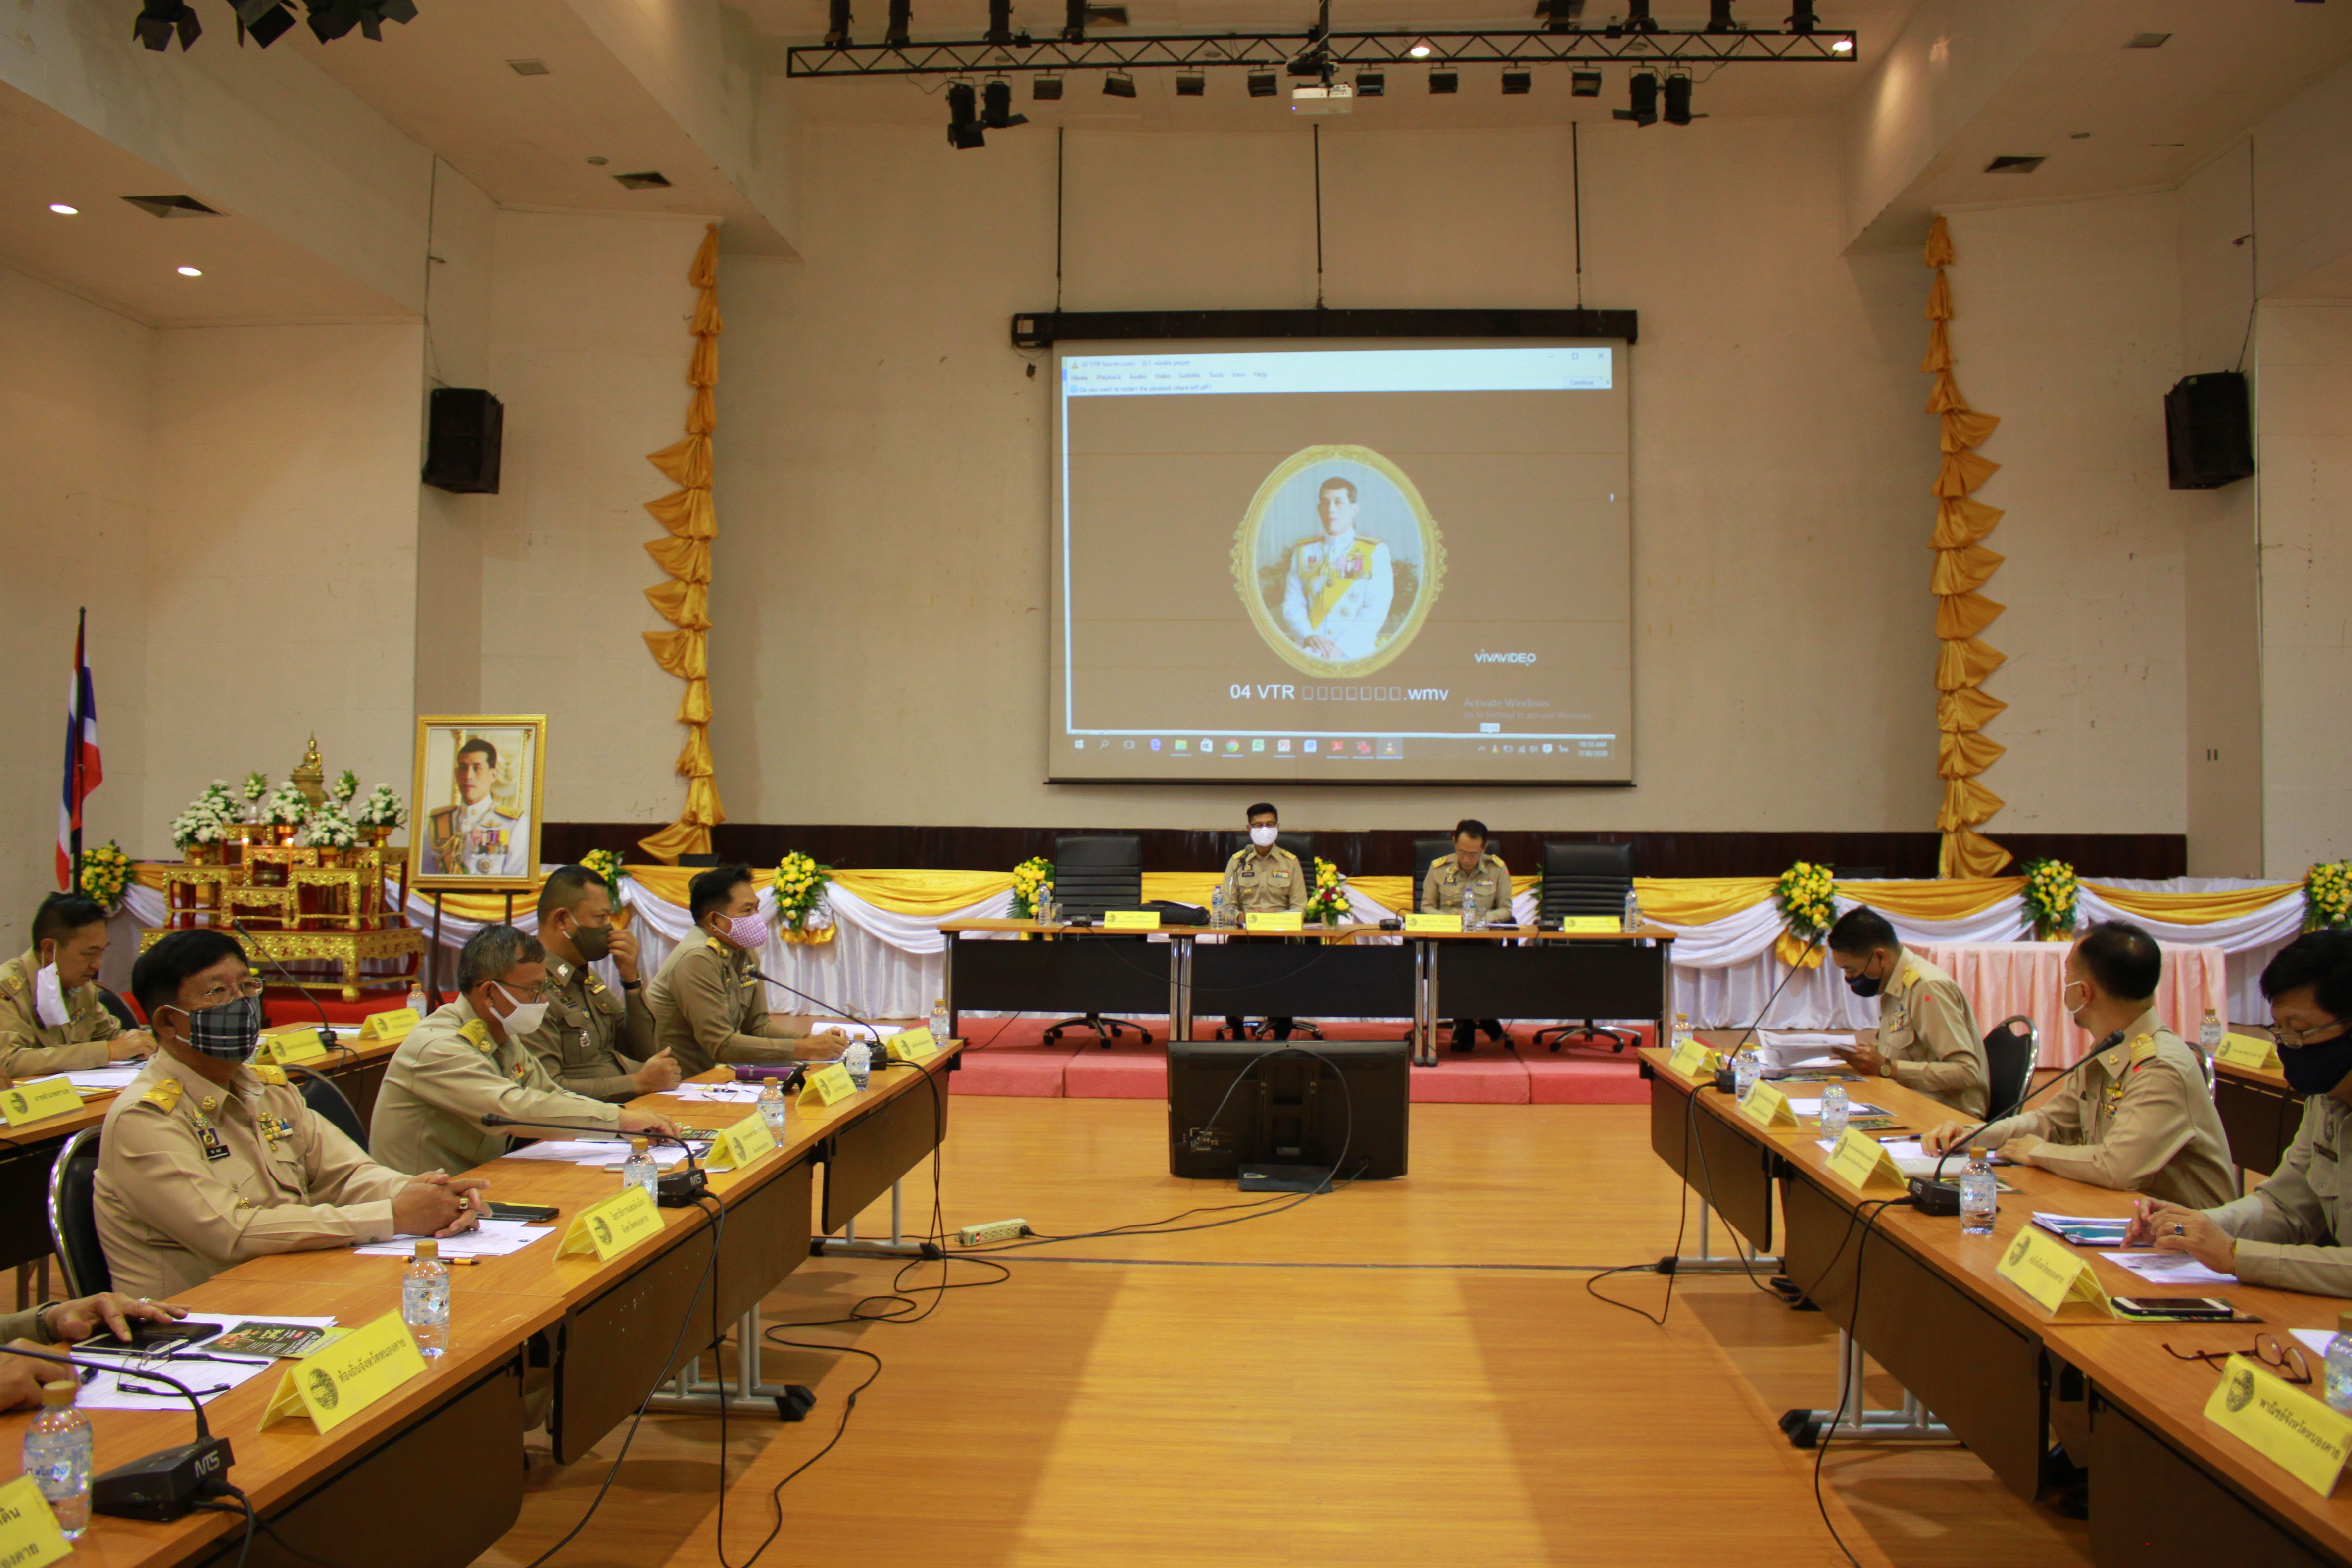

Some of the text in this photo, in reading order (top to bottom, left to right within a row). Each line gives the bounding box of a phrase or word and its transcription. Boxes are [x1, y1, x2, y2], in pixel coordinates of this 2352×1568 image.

[1230, 684, 1449, 701] 04 VTR .wmv
[1464, 698, 1550, 708] Activate Windows
[2259, 1398, 2342, 1461] พาณิชย์จังหวัดหนองคาย
[194, 1449, 221, 1478] NTS
